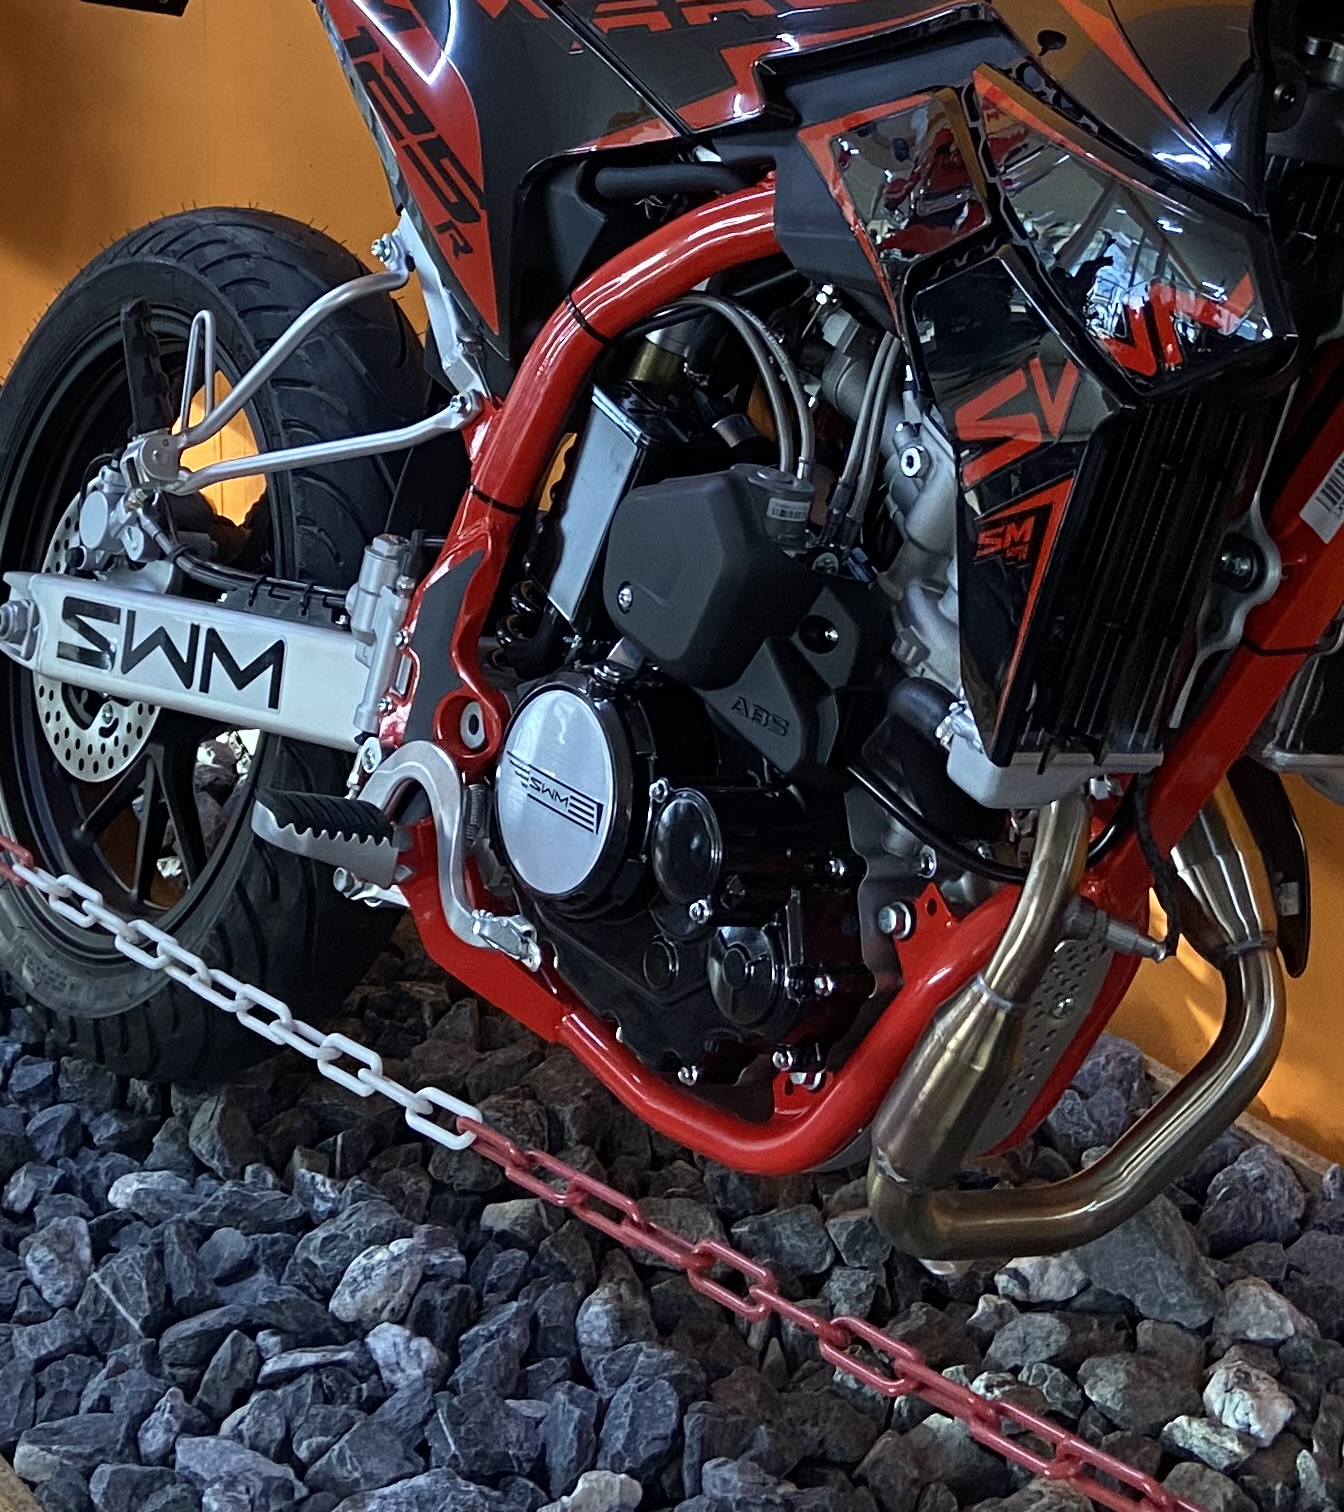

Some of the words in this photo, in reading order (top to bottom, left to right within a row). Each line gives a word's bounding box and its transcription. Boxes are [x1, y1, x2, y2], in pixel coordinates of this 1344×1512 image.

[343, 25, 486, 224] 125
[974, 515, 1036, 559] SM
[56, 595, 286, 711] SWM
[731, 696, 790, 737] ABS
[529, 775, 572, 808] SWM
